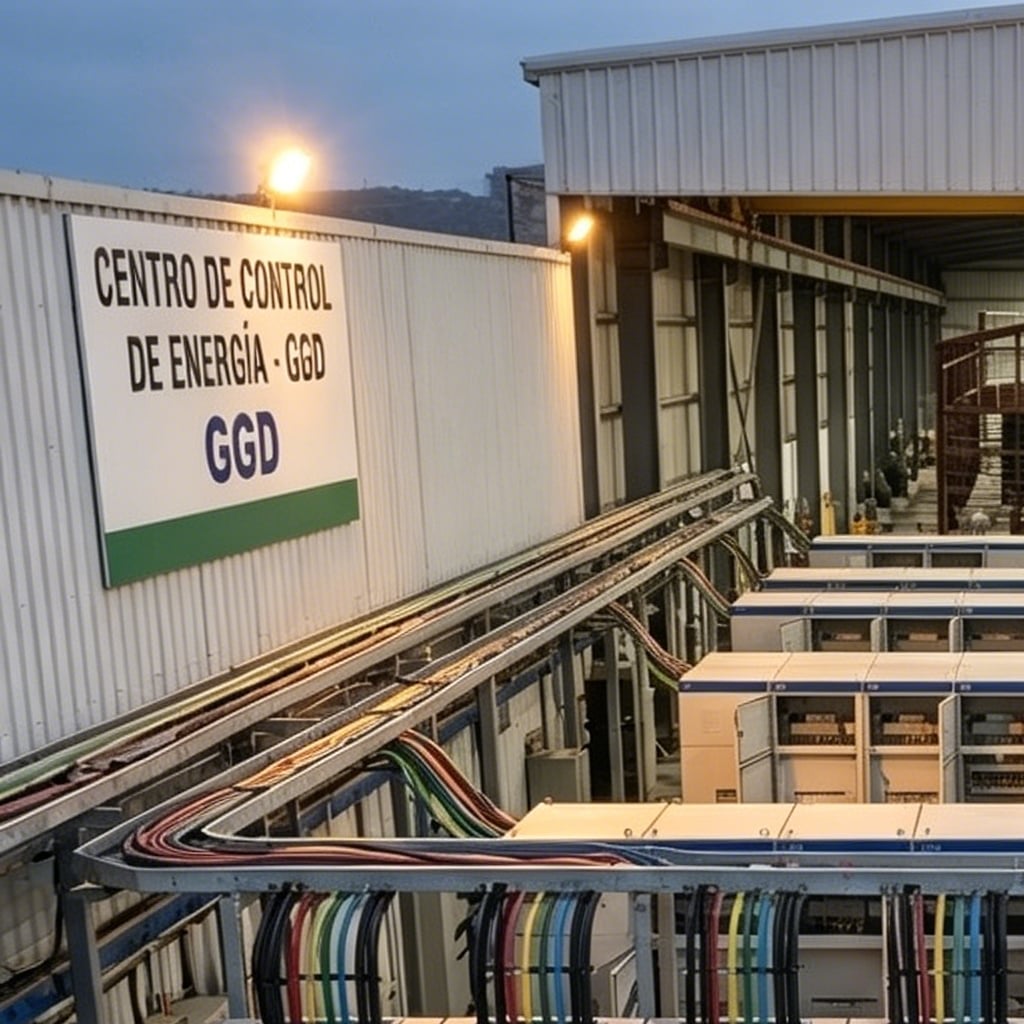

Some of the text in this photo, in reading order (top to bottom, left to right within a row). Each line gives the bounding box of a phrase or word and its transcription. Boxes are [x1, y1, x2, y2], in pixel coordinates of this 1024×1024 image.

[94, 246, 333, 311] CENTRO DE CONTROL
[126, 335, 164, 393] DE
[168, 320, 269, 390] ENERGÍA
[285, 332, 326, 383] GGD
[204, 410, 280, 484] GGD
